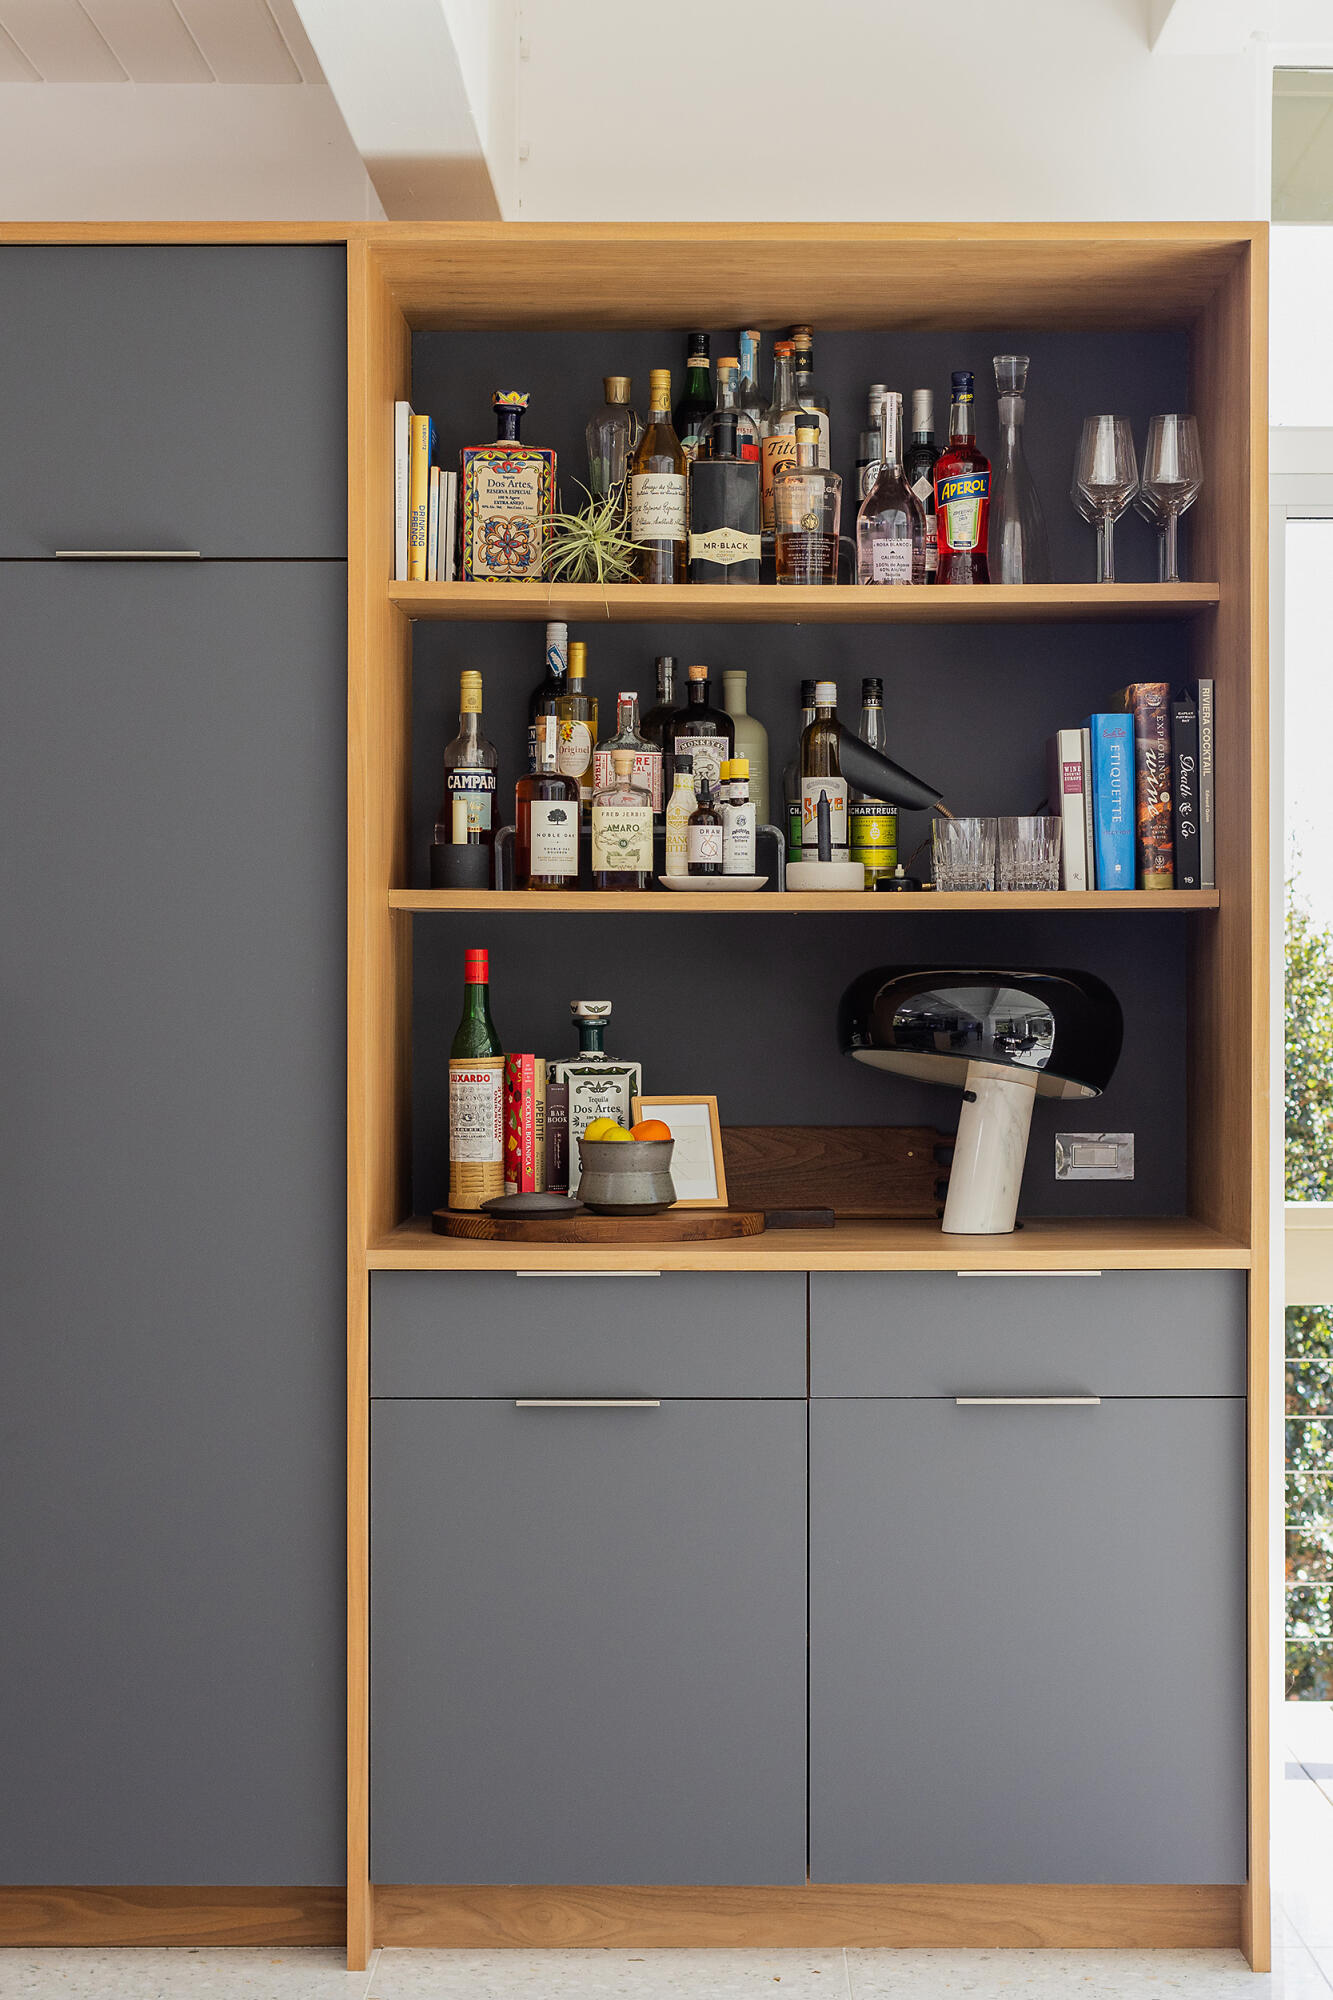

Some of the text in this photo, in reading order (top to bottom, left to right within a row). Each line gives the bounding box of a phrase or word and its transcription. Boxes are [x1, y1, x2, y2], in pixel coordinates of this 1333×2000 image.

[767, 440, 797, 457] Tito
[487, 479, 532, 489] Dos Artes
[942, 480, 986, 500] APEROL
[411, 511, 419, 548] FRENCH
[418, 505, 426, 548] DRINKING
[1202, 687, 1212, 777] RIVIERA COCKTAIL
[679, 738, 715, 751] MONKEY
[1144, 715, 1168, 818] EXPLORING wine
[447, 775, 496, 790] CAMPARI
[1109, 744, 1122, 824] ETIQUETTE
[1178, 754, 1197, 840] Death & Co
[850, 806, 899, 816] CHARTREUSE
[605, 823, 641, 833] AMARO
[450, 1073, 491, 1083] LUXARDO
[573, 1104, 593, 1114] Dos
[595, 1103, 621, 1114] Artes
[588, 1096, 609, 1105] Tequila
[535, 1099, 545, 1142] APERITIF
[550, 1109, 566, 1117] BAR
[525, 1096, 533, 1167] COCKTAIL BOTANICA
